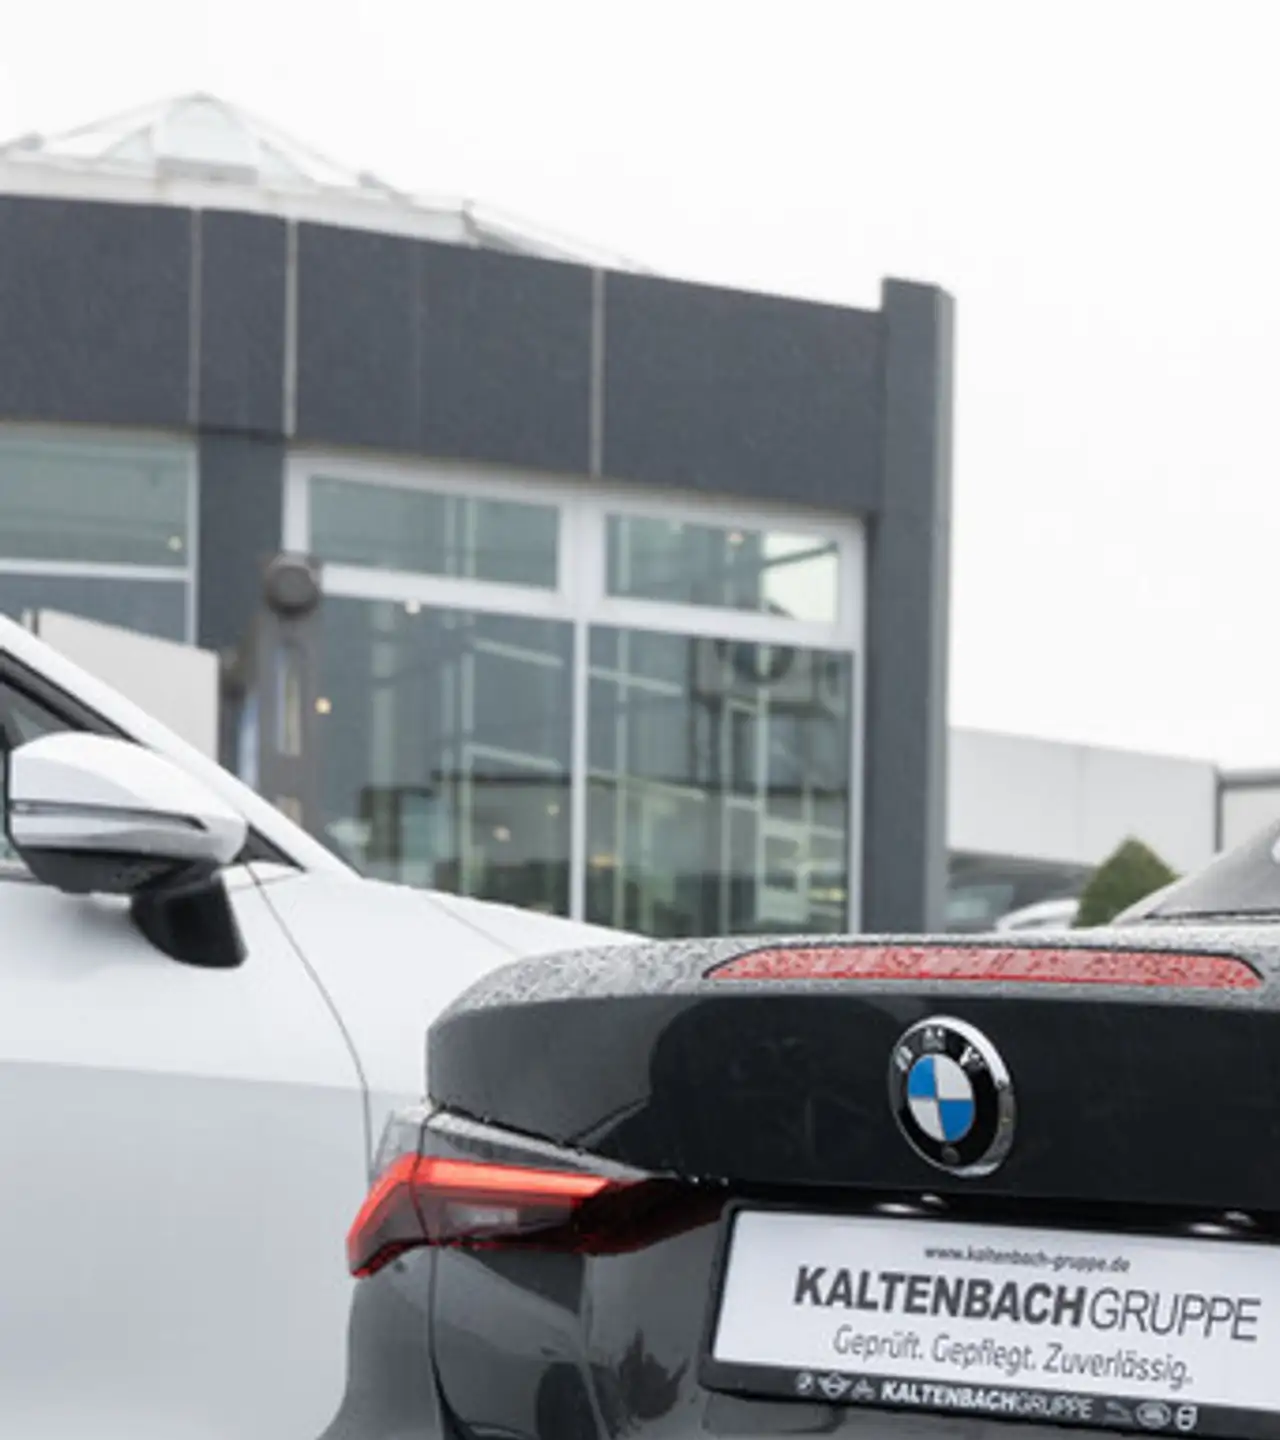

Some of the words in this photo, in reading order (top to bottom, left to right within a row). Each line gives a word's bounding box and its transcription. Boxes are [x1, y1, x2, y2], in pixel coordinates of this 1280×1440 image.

[924, 1245, 1131, 1273] www.kaltenbach-gruppe.de
[793, 1265, 1261, 1342] KALTENBACHGRUPPE
[833, 1323, 924, 1360] Geprüft.
[930, 1334, 1037, 1377] Gepflegt.
[1041, 1341, 1194, 1391] Zuverlässig.
